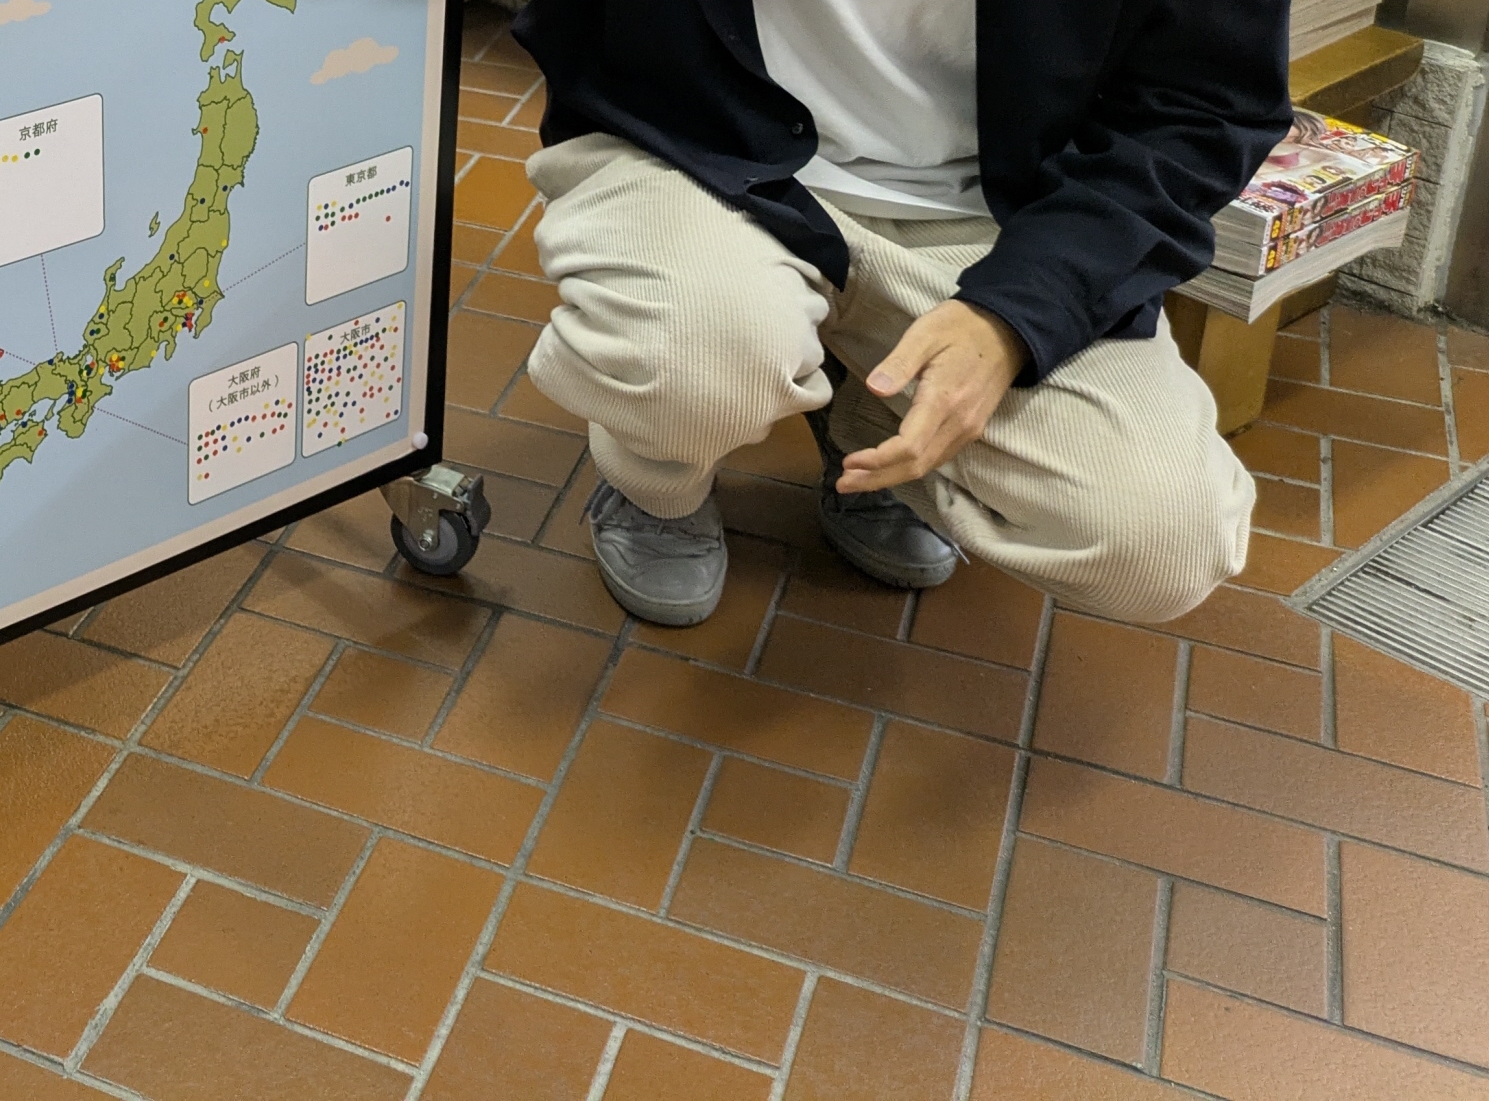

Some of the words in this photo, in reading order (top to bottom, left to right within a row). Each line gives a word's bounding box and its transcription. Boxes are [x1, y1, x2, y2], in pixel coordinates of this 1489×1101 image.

[19, 118, 59, 142] 京都府
[344, 165, 378, 187] 東京都
[339, 324, 371, 345] 大阪市
[227, 365, 261, 388] 大阪府
[208, 374, 280, 414] (大阪市以外)
